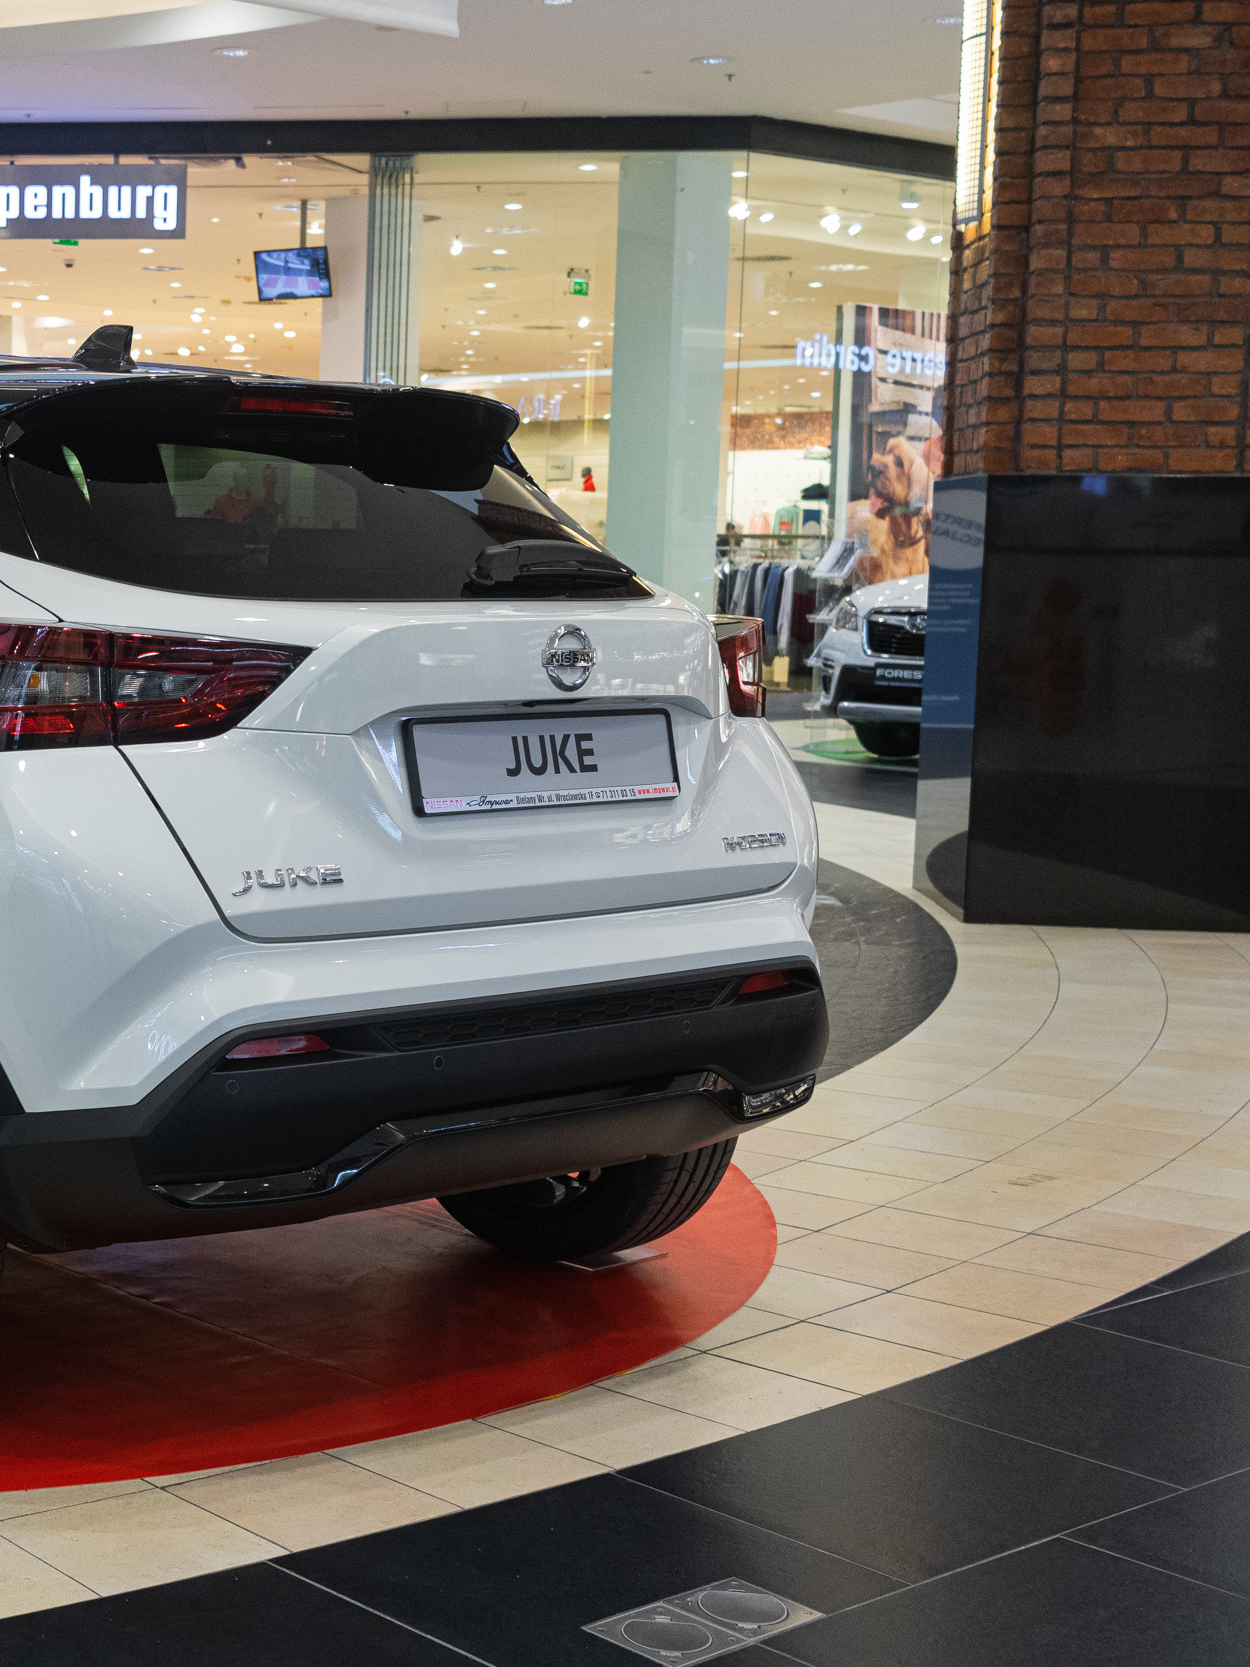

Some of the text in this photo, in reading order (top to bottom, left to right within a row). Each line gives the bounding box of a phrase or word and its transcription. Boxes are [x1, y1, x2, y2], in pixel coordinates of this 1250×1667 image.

[550, 652, 594, 664] NISSAN
[876, 668, 924, 680] FORES
[505, 732, 599, 777] JUKE
[515, 795, 536, 805] Bielany
[536, 794, 547, 804] Wr.
[547, 793, 555, 803] ul.
[587, 791, 594, 800] 1F
[600, 790, 608, 799] 71
[608, 789, 620, 798] 311
[620, 788, 629, 798] 03
[629, 788, 637, 797] 15
[637, 784, 678, 796] www.impwar.pl
[425, 799, 464, 810] NISSAN
[476, 795, 514, 808] Impwar
[231, 864, 345, 897] JUKE
